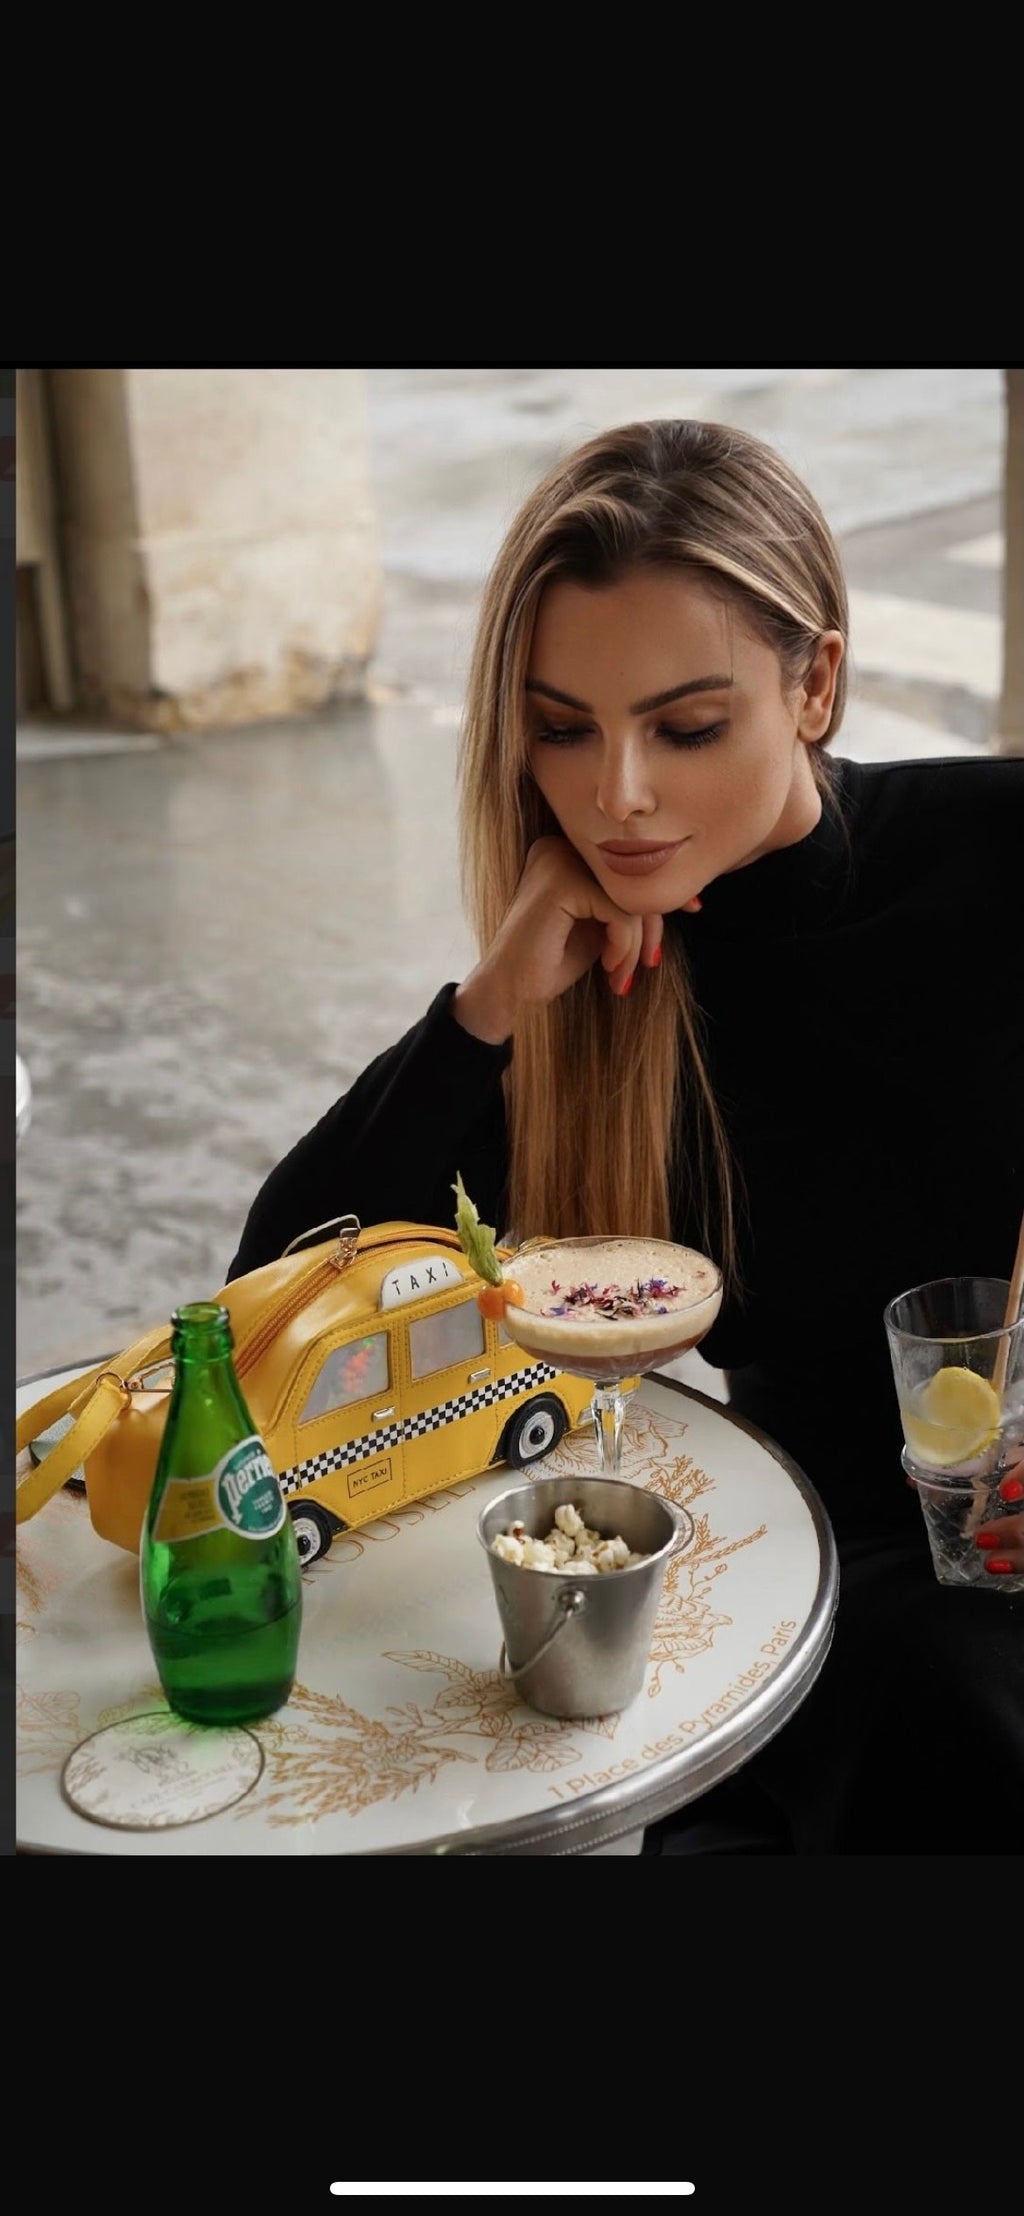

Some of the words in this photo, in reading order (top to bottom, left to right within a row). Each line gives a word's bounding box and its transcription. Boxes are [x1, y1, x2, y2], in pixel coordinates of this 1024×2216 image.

[391, 1262, 449, 1295] TAXI
[353, 1475, 368, 1488] NYC
[371, 1467, 387, 1481] TAXI
[547, 1784, 565, 1800] 1
[565, 1758, 640, 1794] Place
[641, 1734, 684, 1761] des
[760, 1620, 797, 1656] Paris
